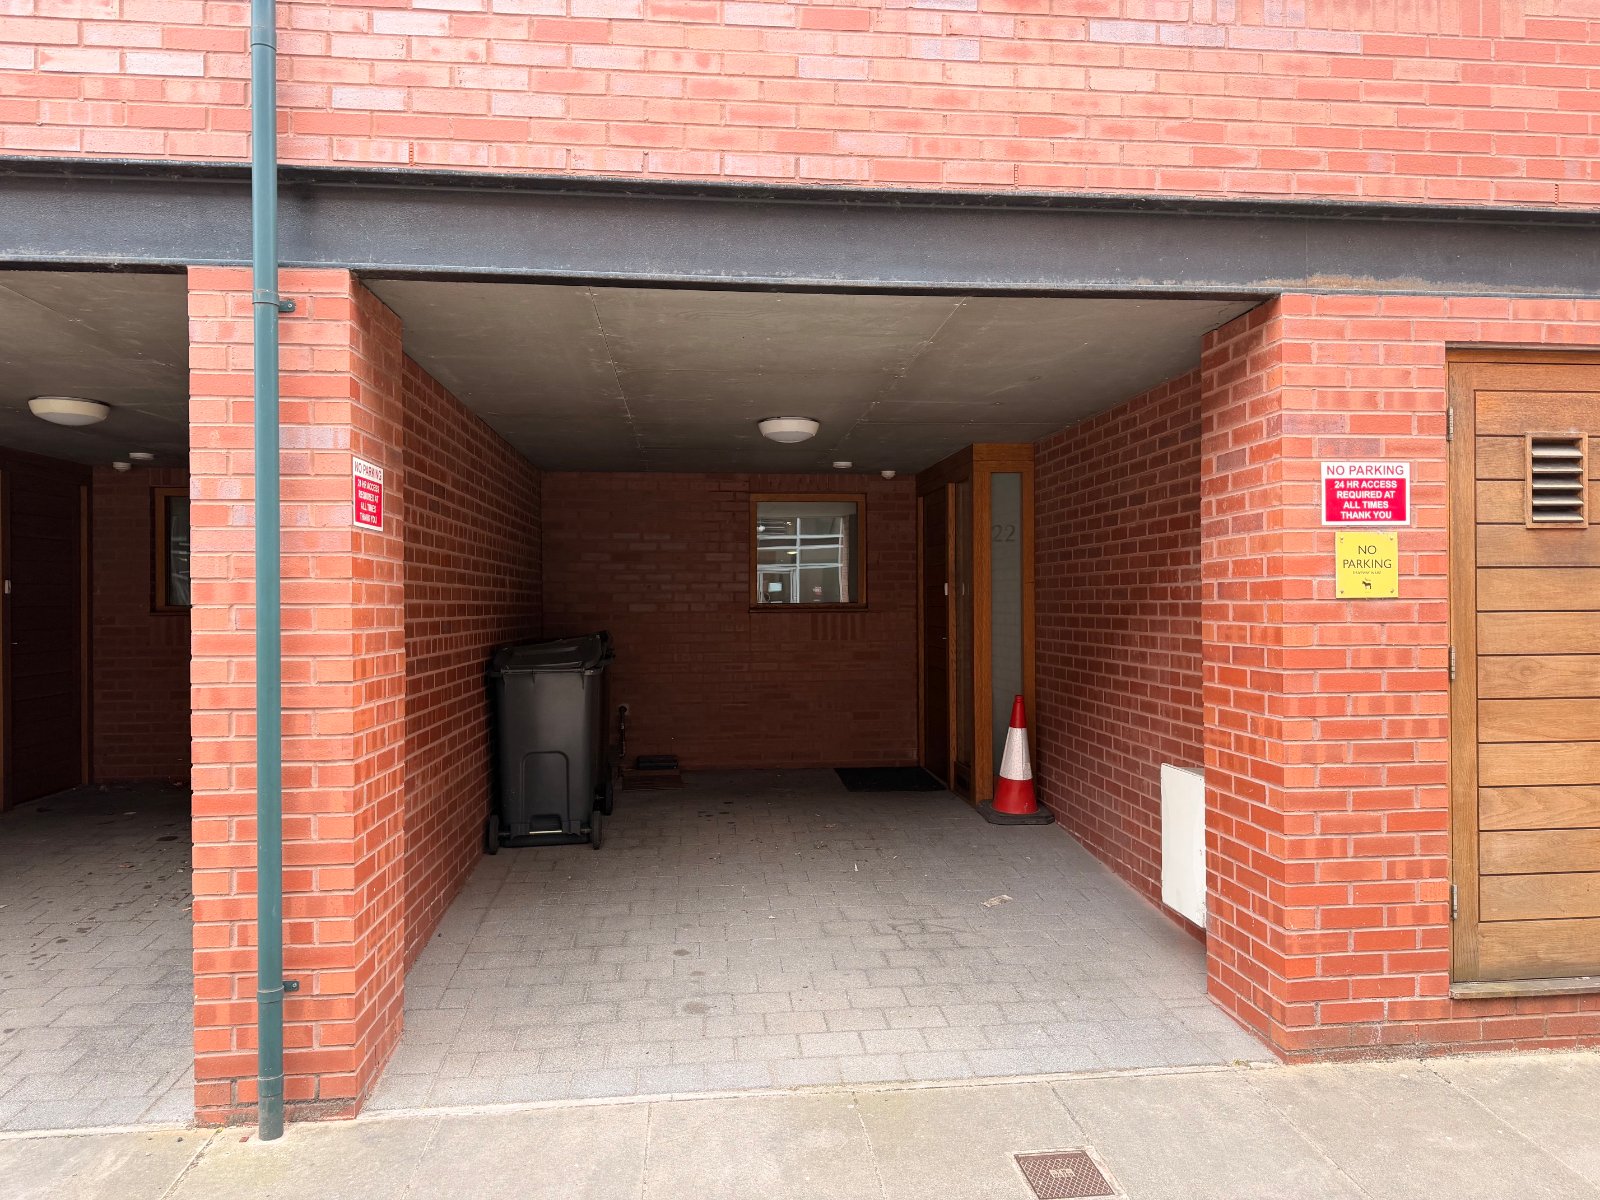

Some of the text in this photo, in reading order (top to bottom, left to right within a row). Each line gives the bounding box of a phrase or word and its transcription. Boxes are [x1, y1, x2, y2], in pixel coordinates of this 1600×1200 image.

[354, 460, 382, 481] NO PARKING
[1326, 465, 1404, 476] NO PARKING
[1334, 480, 1398, 489] 24 HR ACCESS
[1336, 490, 1396, 499] REQUIRED AT
[1343, 501, 1389, 509] ALL TIMES
[1340, 511, 1392, 519] THANK YOU
[992, 524, 1016, 542] 22
[1357, 545, 1377, 555] NO
[1342, 558, 1392, 569] PARKING
